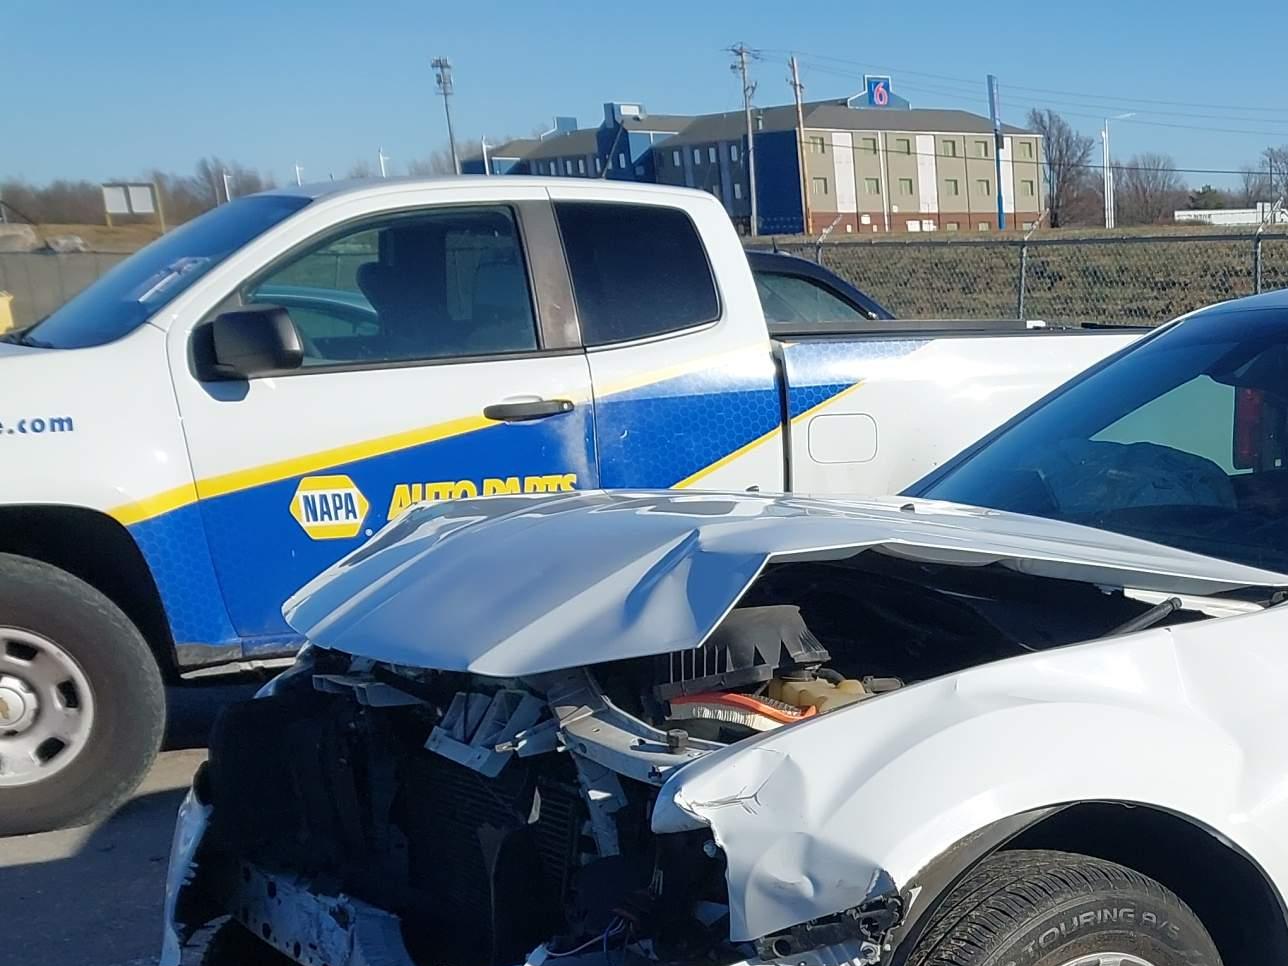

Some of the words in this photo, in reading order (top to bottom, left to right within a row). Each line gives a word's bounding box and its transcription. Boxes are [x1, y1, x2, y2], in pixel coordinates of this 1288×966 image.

[873, 82, 889, 106] 6
[0, 416, 74, 434] .com
[302, 492, 358, 522] NAPA
[1022, 907, 1135, 958] TOURING
